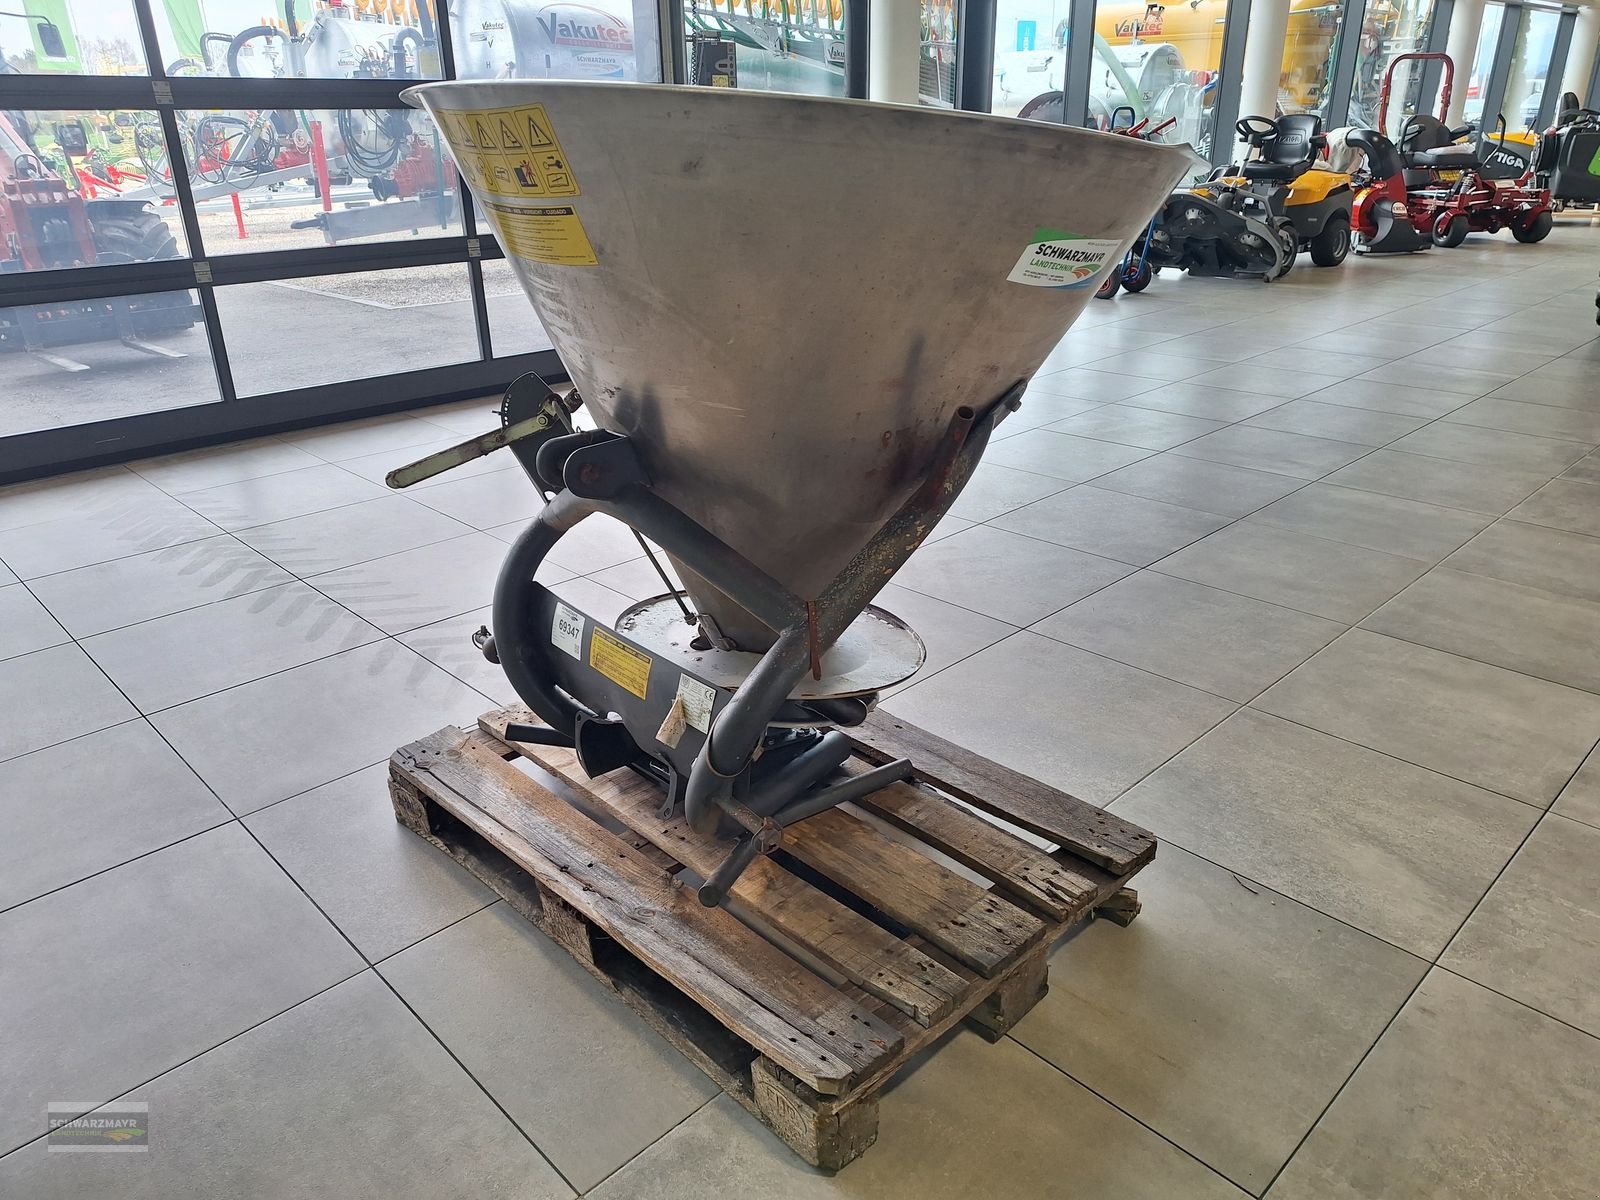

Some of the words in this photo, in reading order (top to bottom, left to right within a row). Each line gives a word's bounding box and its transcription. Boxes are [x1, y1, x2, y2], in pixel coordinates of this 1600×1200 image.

[536, 12, 630, 44] Vakutec
[1493, 151, 1524, 169] TIGA
[1035, 243, 1106, 263] SCHWARZMAYR
[1030, 258, 1074, 272] LANDTECHNIK
[559, 619, 580, 639] 69347
